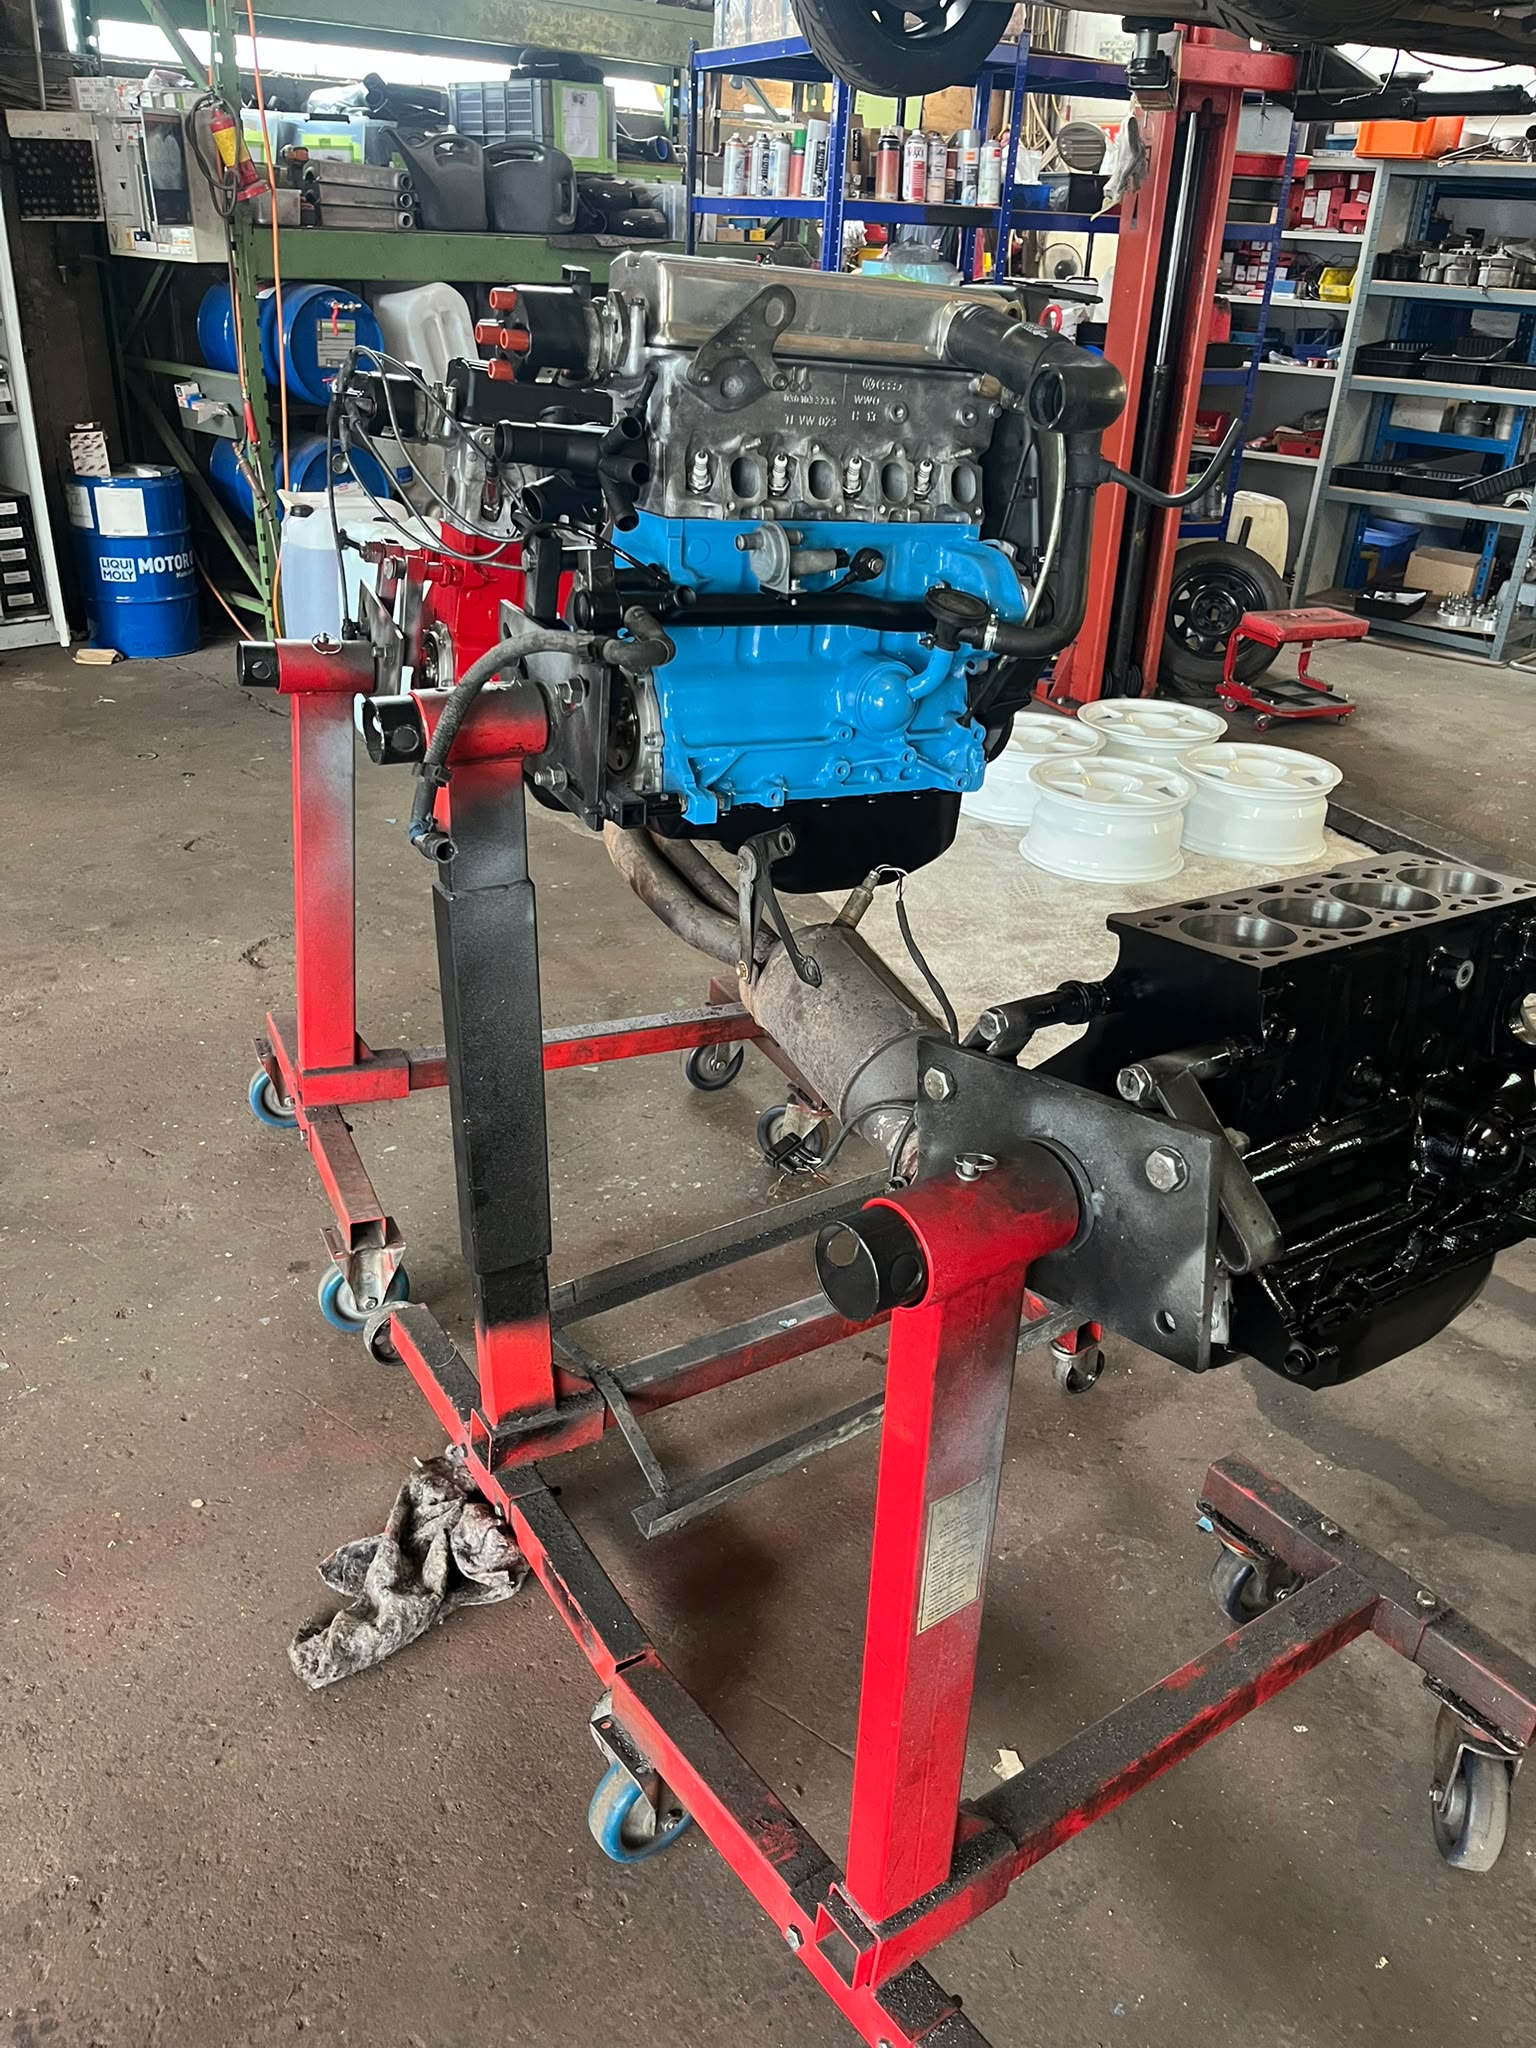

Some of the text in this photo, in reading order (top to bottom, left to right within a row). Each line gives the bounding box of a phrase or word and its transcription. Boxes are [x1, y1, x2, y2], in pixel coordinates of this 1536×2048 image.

[101, 559, 133, 569] LIQUI
[137, 553, 189, 575] MOTOR
[103, 570, 134, 581] MOLY
